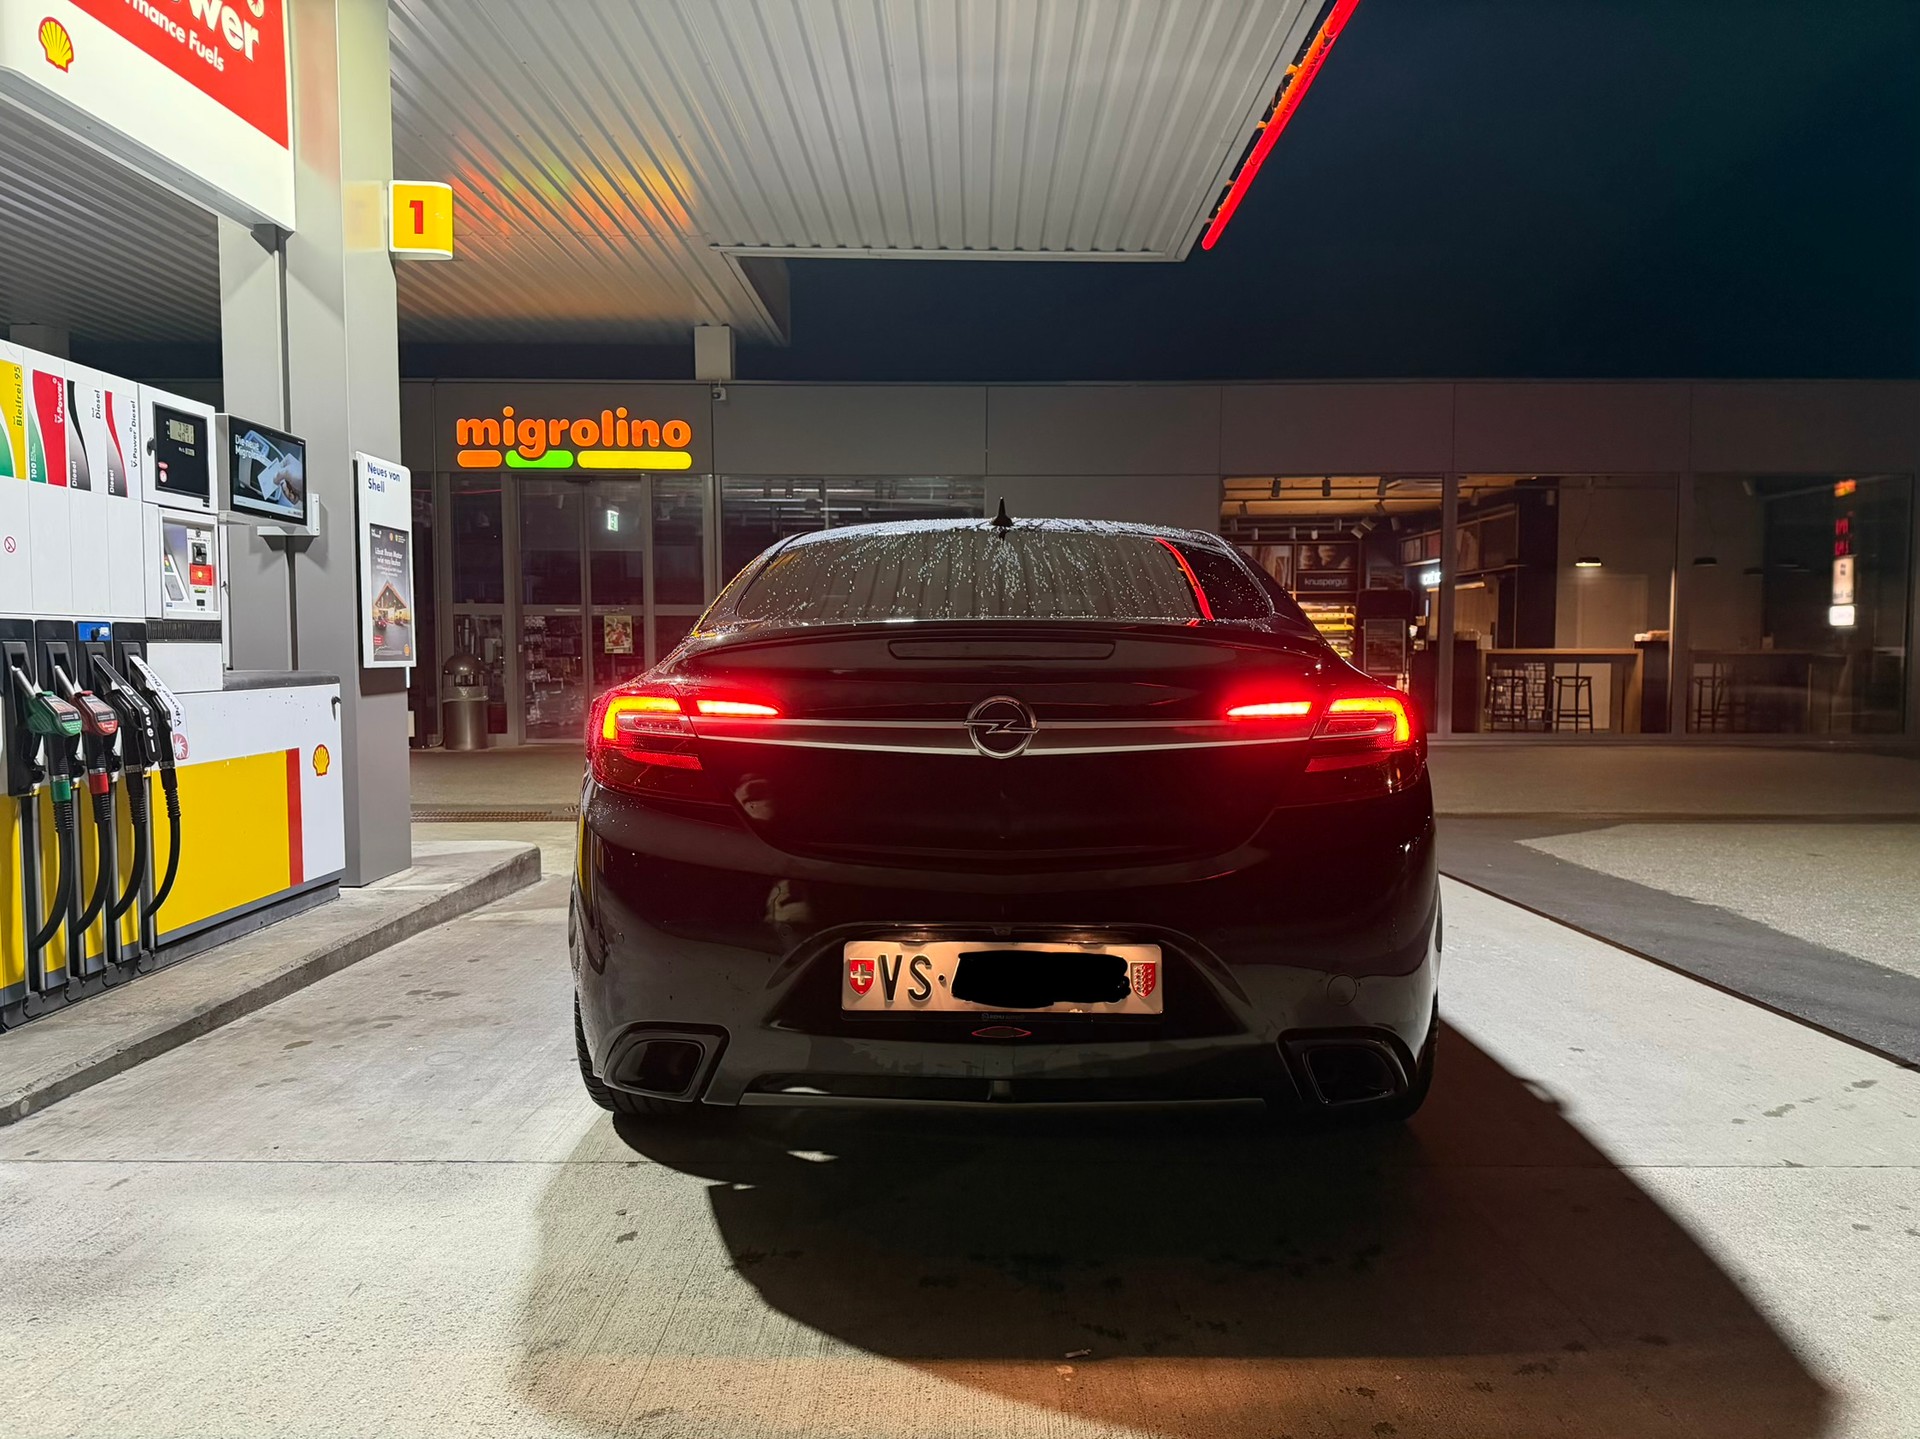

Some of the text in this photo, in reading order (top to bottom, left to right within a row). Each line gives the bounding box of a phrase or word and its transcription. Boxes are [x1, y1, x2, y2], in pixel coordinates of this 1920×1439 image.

[189, 29, 225, 72] Fuels
[409, 200, 424, 235] 1
[14, 366, 22, 427] Bleifrei 95
[456, 405, 692, 459] migrolino
[367, 462, 401, 482] Neues von
[367, 478, 385, 493] Shell
[121, 684, 157, 753] Diesel
